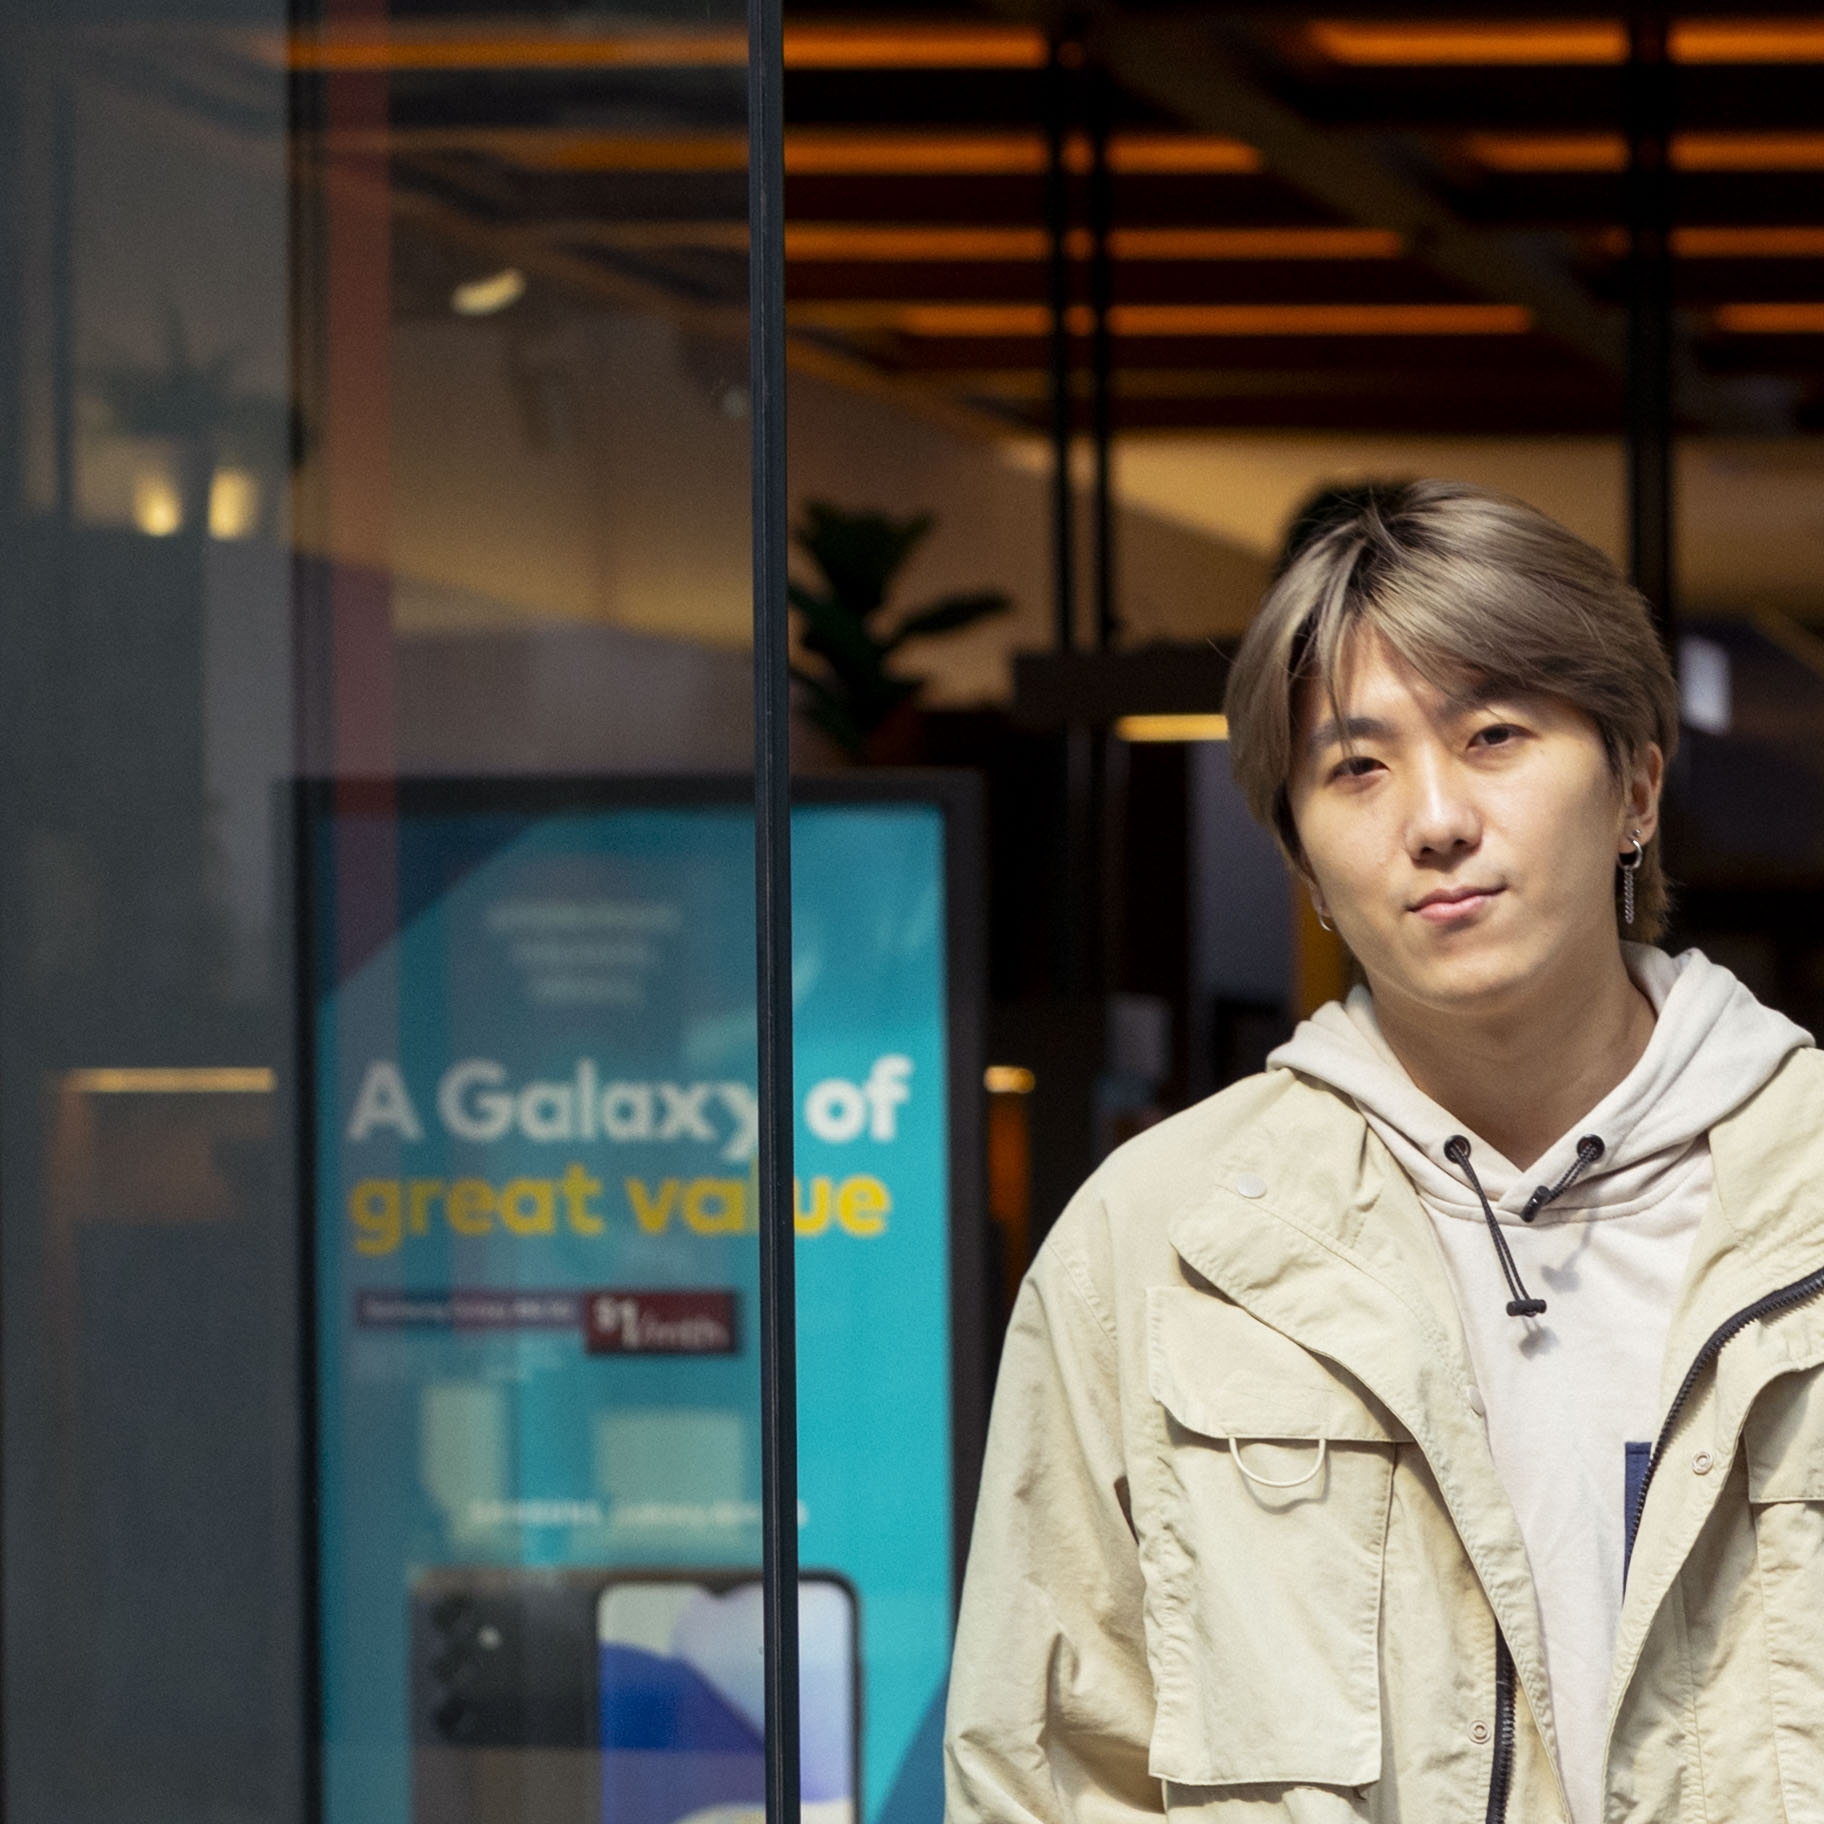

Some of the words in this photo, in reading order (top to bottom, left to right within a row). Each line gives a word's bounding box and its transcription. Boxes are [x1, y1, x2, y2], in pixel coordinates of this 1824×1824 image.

[346, 1060, 426, 1142] A
[436, 1056, 758, 1163] Galaxy
[803, 1053, 914, 1143] of
[347, 1163, 606, 1256] great
